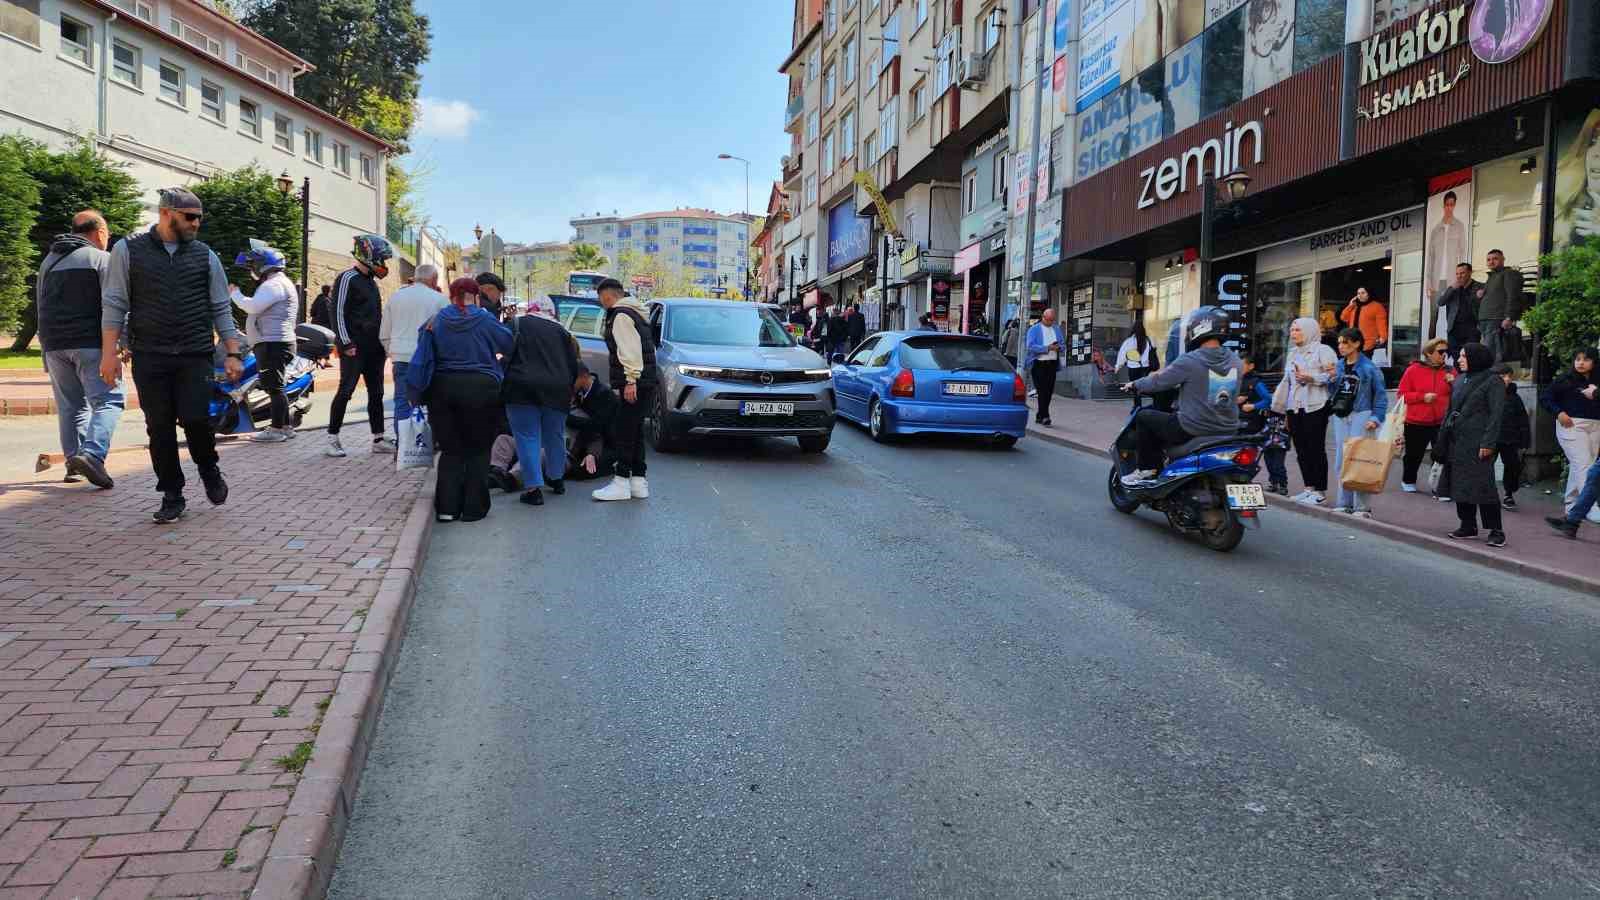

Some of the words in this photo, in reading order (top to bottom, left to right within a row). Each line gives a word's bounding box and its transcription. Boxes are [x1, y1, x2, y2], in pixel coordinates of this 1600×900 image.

[1137, 120, 1264, 210] zemin
[1310, 228, 1355, 251] BARRELS
[1359, 219, 1386, 239] AND
[1391, 213, 1412, 231] OIL
[746, 402, 755, 412] 34
[760, 403, 774, 412] HZA
[777, 403, 793, 413] 940
